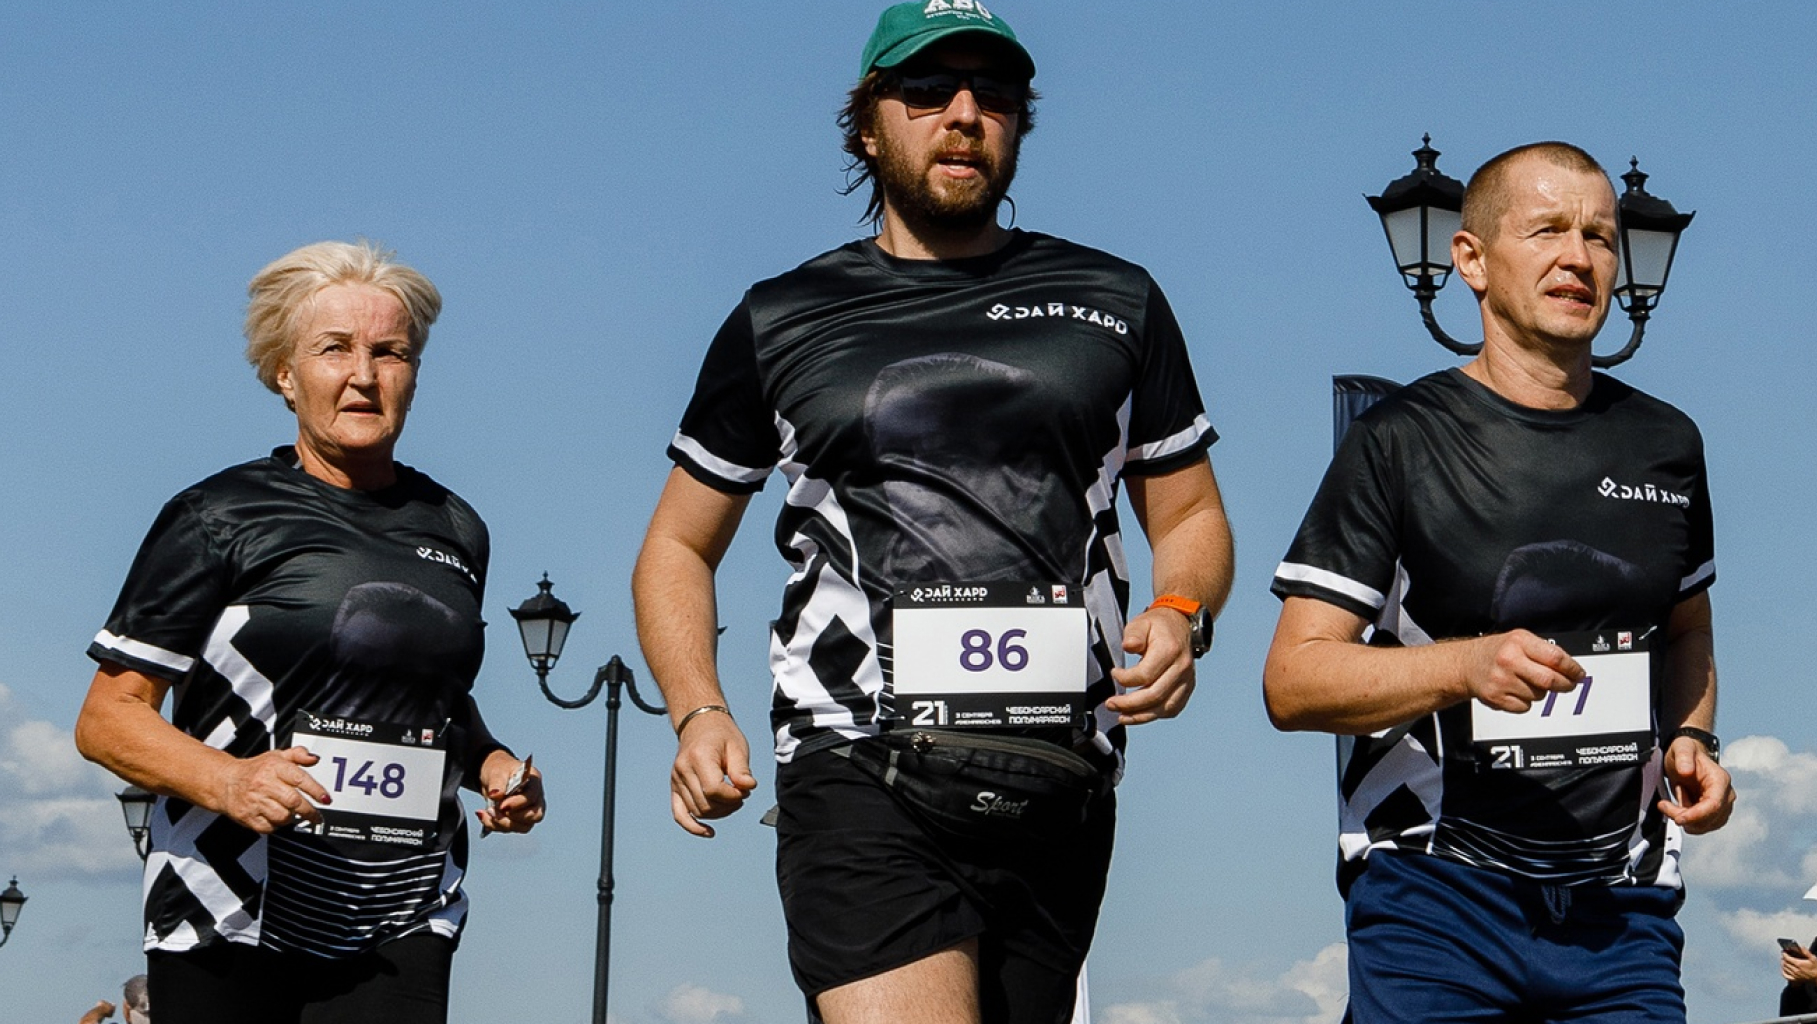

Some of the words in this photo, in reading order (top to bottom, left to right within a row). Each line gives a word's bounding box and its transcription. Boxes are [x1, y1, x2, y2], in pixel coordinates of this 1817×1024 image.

[959, 628, 1029, 672] 86
[911, 701, 946, 725] 21
[1490, 745, 1522, 769] 21
[332, 756, 405, 799] 148
[970, 791, 1029, 815] Sport
